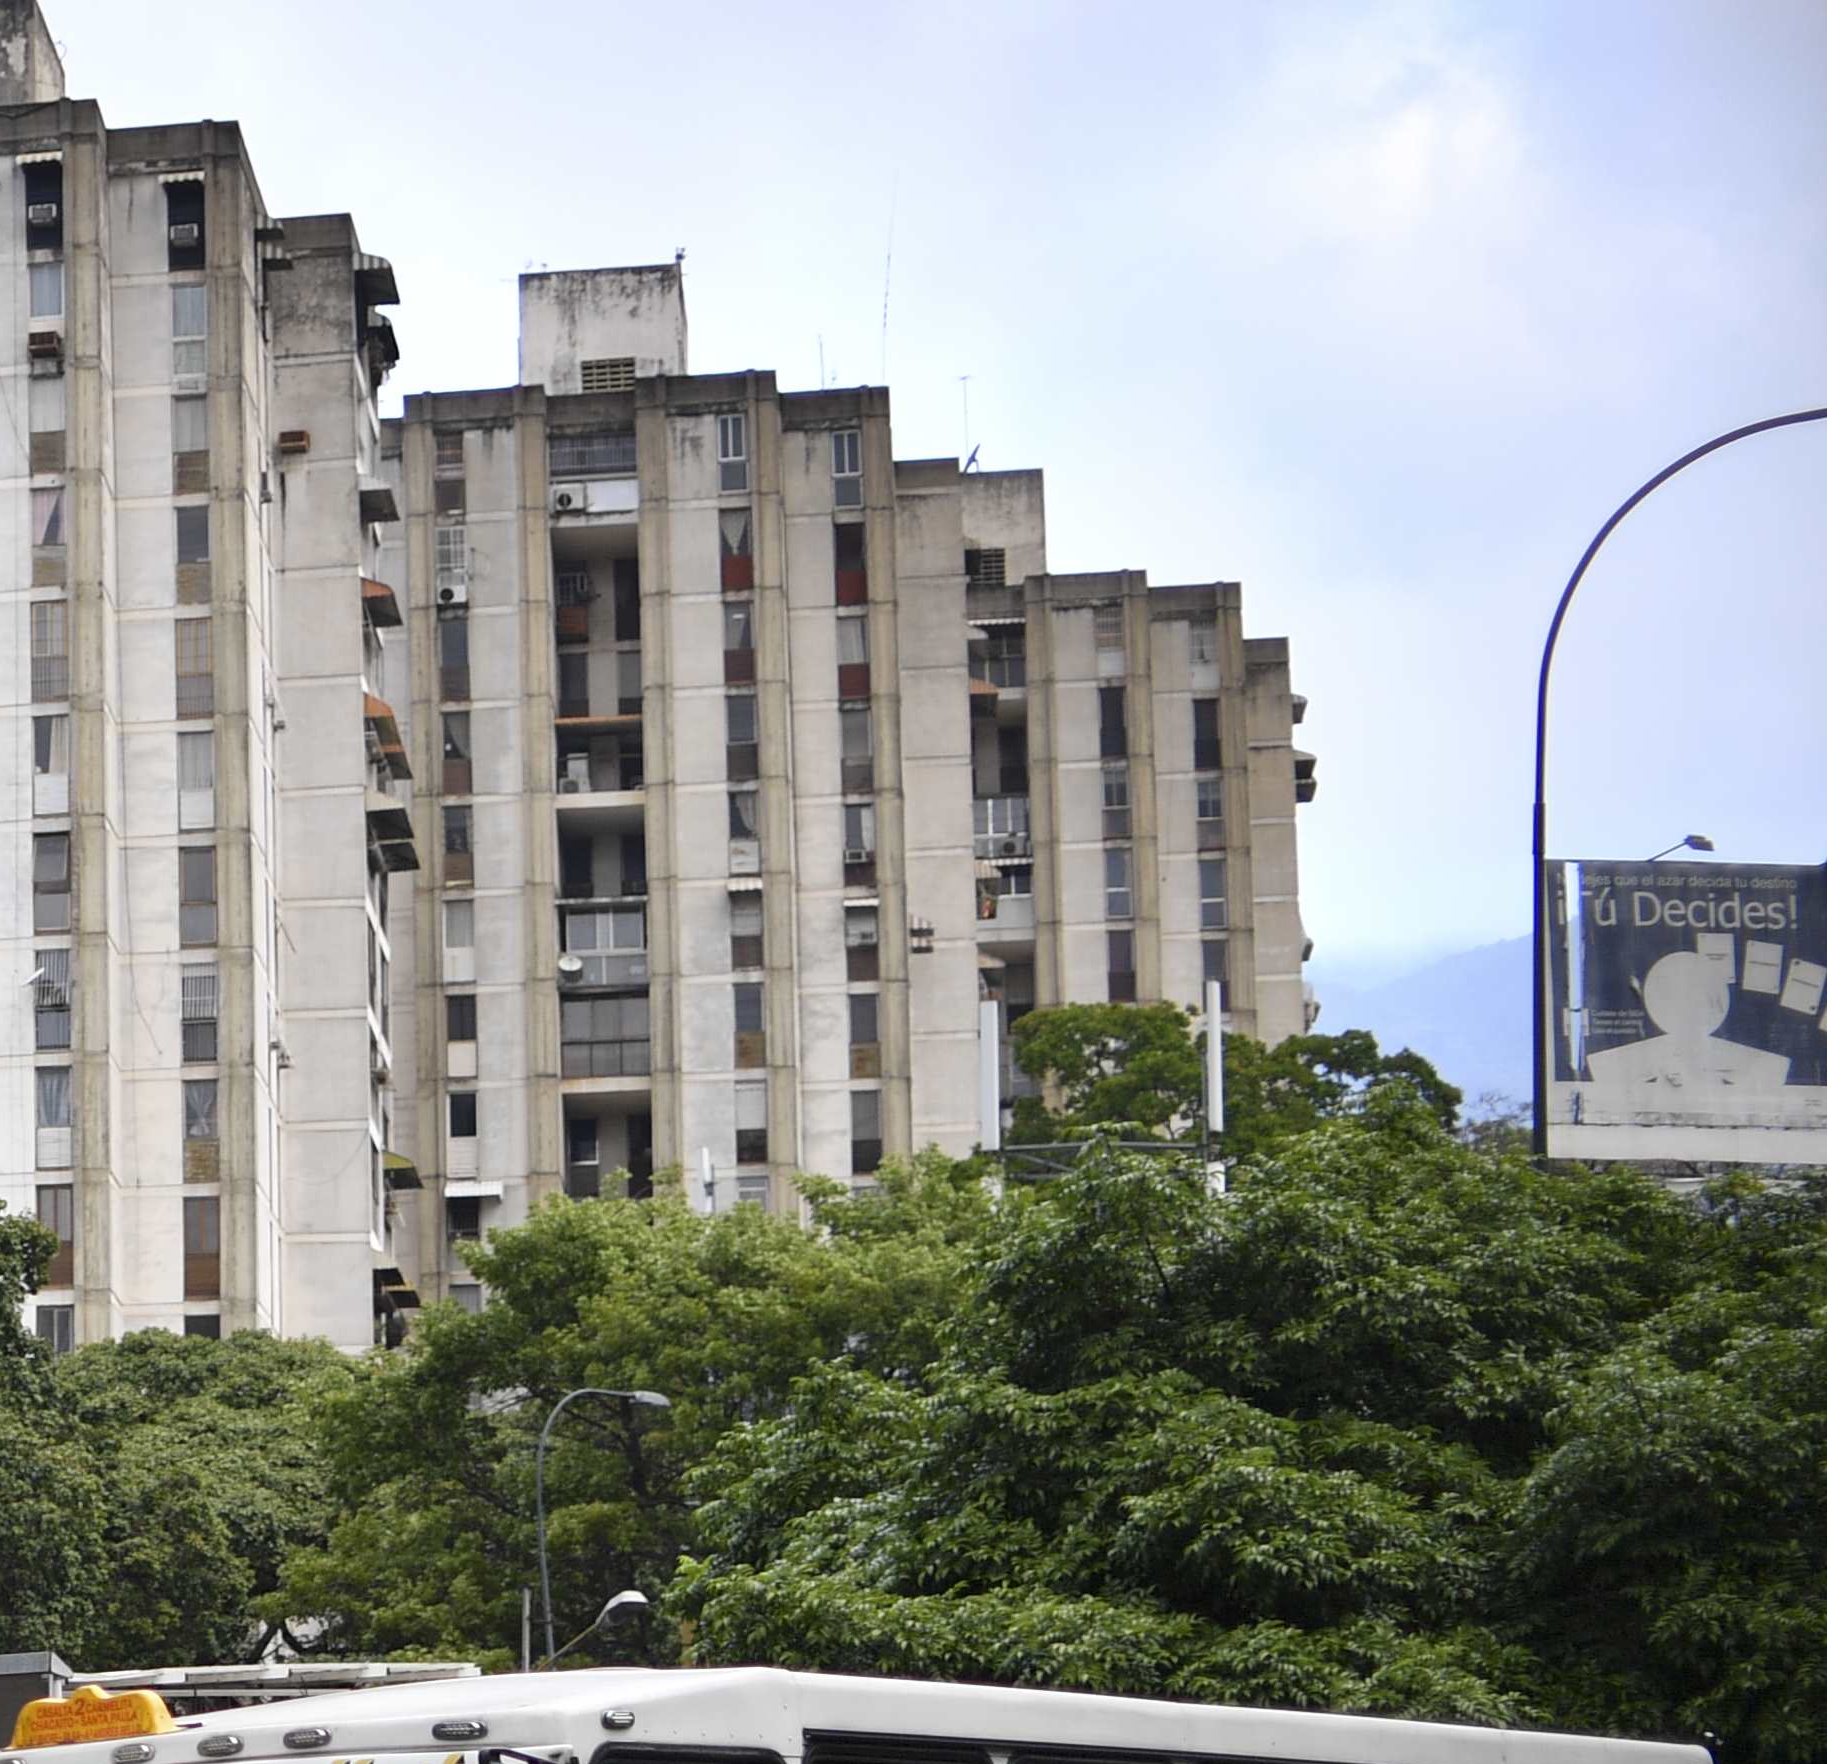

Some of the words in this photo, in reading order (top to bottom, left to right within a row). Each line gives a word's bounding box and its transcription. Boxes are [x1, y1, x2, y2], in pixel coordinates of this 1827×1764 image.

[1614, 875, 1639, 888] que
[1641, 874, 1654, 886] el
[1657, 876, 1685, 887] azar
[1687, 875, 1732, 889] decida
[1735, 877, 1749, 888] tu
[1750, 876, 1798, 889] destino
[1633, 891, 1798, 930] Decides!
[74, 1698, 86, 1717] 2
